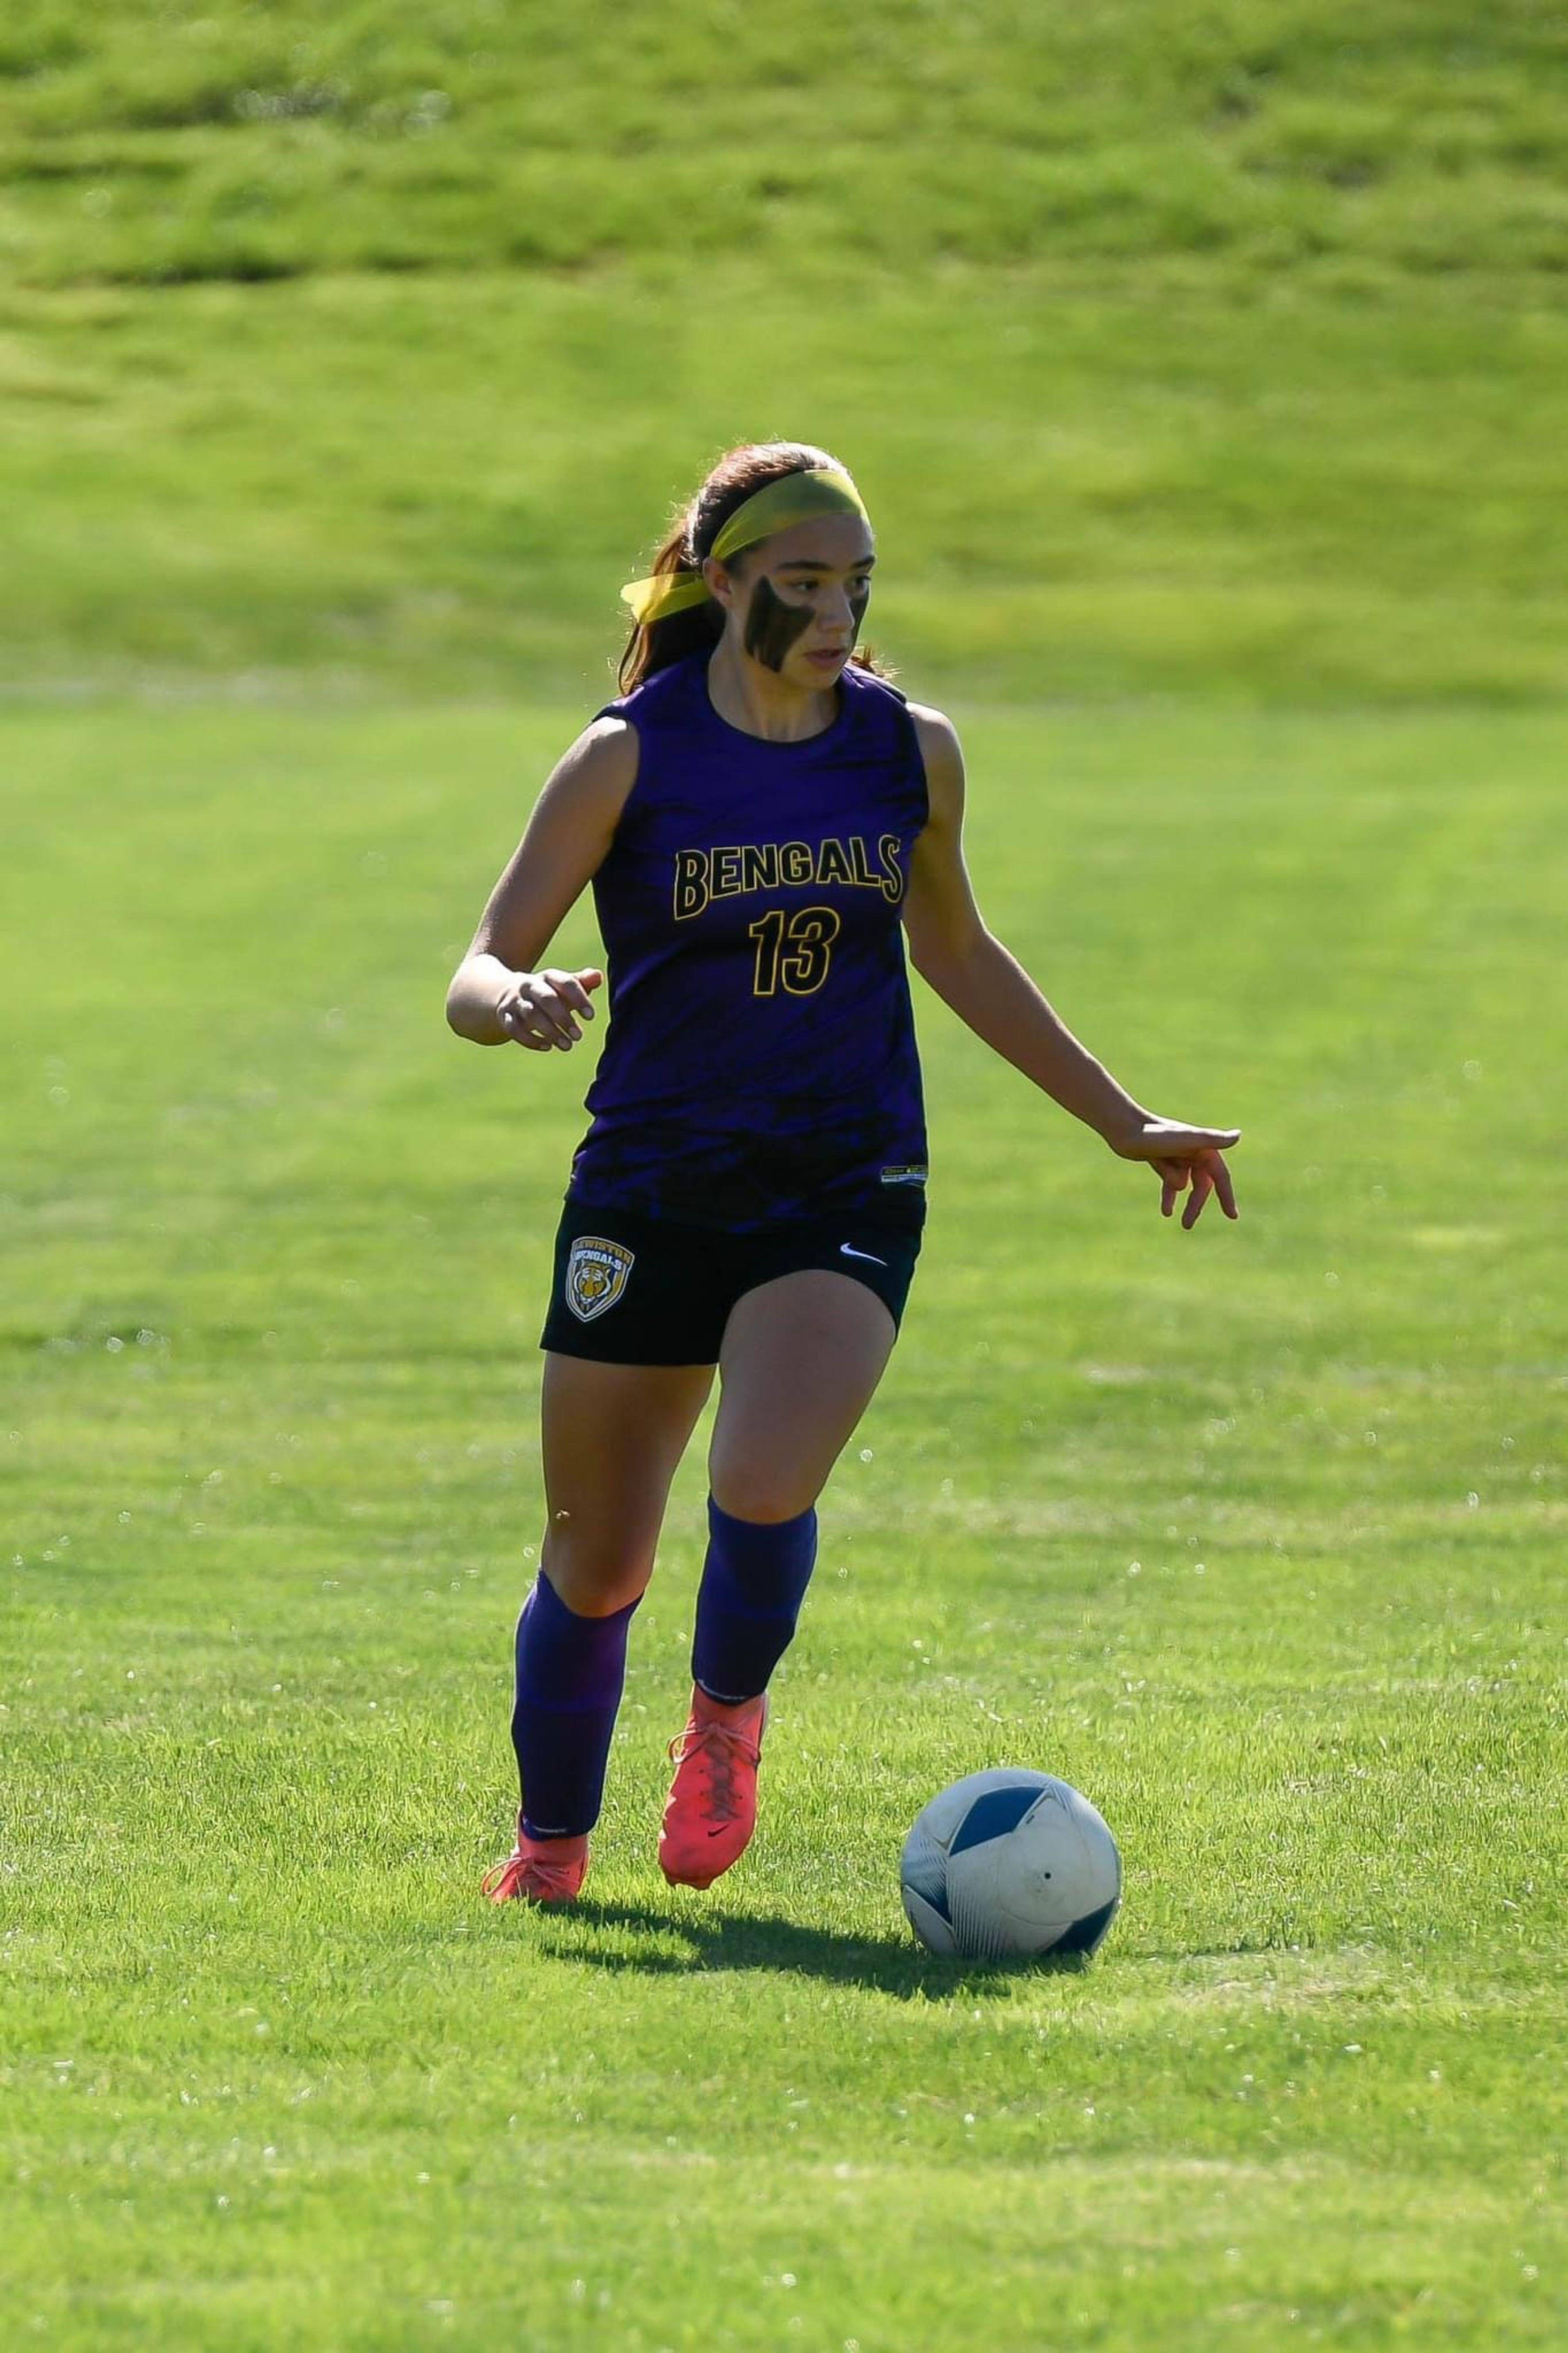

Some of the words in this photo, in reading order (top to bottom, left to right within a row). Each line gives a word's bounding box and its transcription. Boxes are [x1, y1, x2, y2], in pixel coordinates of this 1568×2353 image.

[674, 834, 903, 920] BENGALS
[749, 906, 840, 996] 13
[575, 1249, 622, 1270] BENGALS
